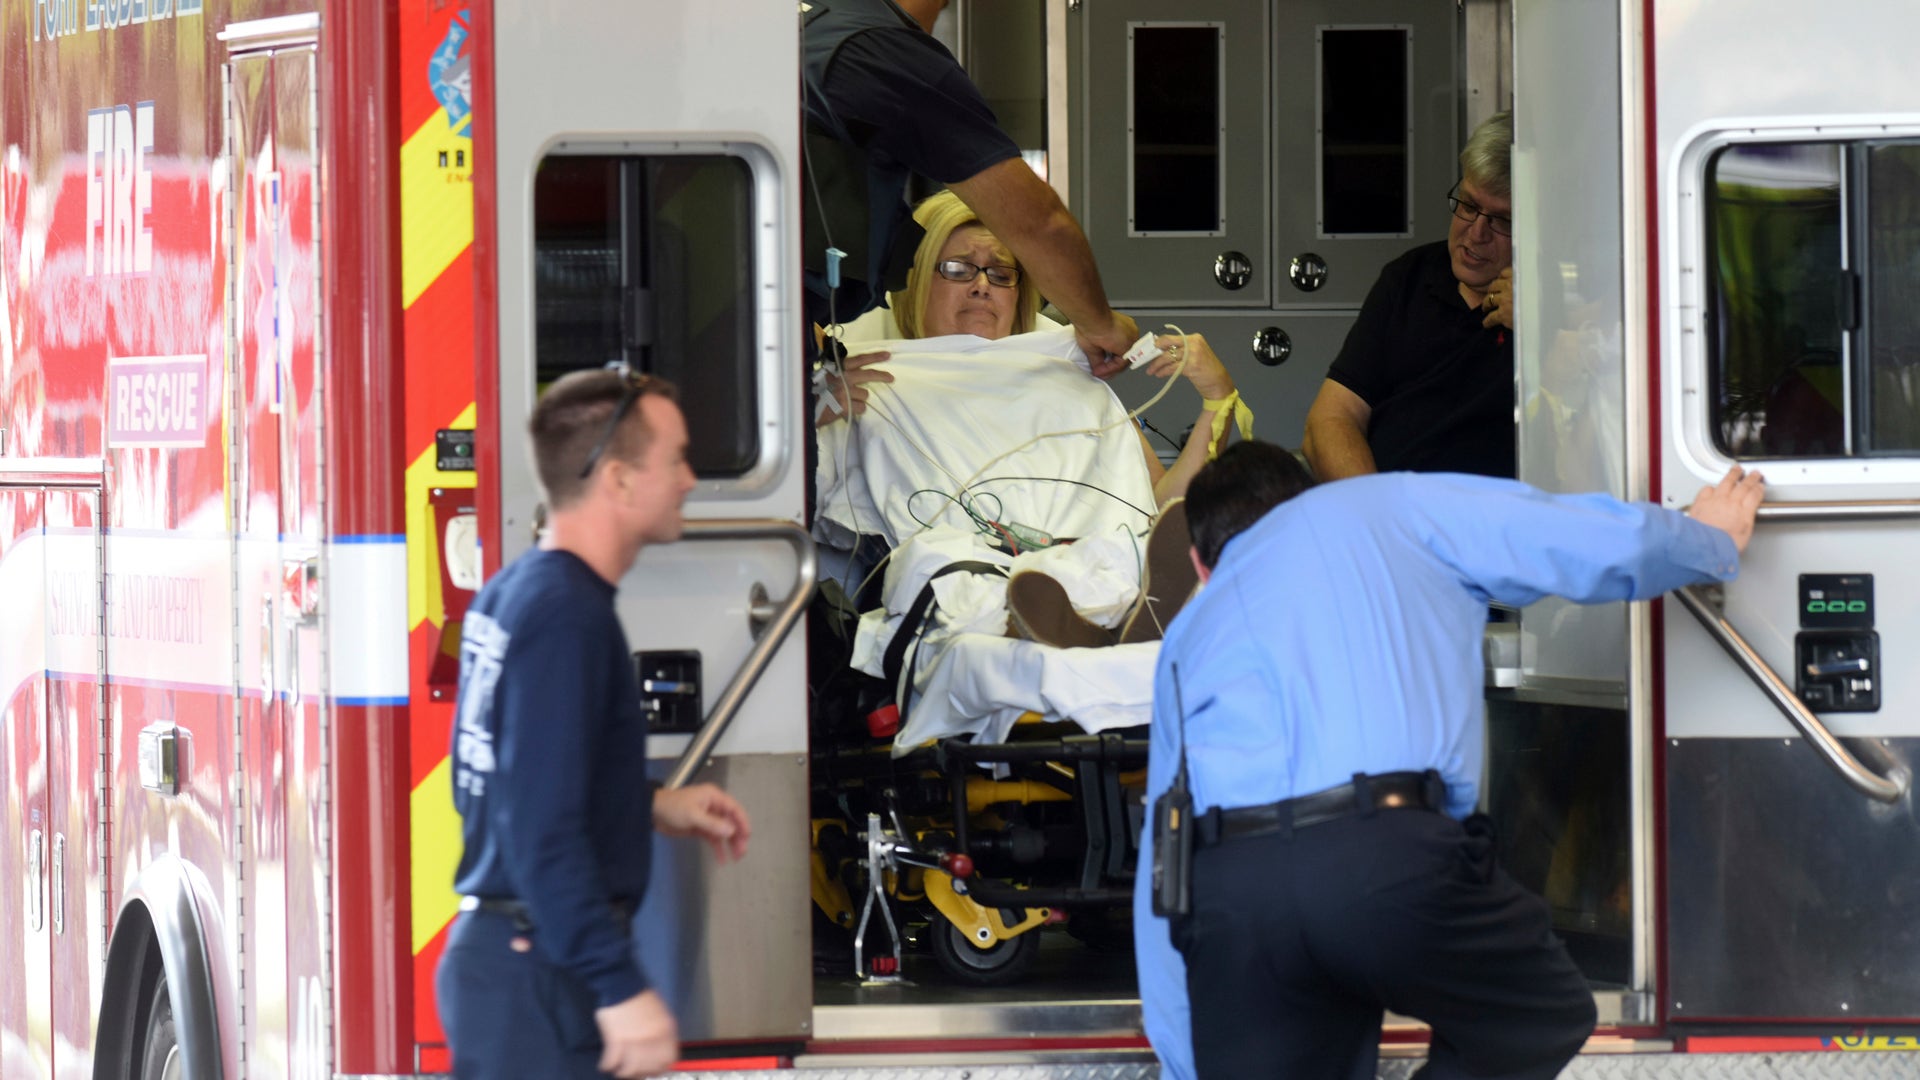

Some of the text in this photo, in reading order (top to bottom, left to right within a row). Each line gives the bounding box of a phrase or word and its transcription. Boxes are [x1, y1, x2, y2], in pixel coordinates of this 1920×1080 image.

[85, 100, 155, 281] FIRE
[116, 371, 199, 432] RESCUE
[90, 572, 117, 637] LE
[119, 573, 144, 639] AND
[147, 575, 206, 645] PROPERTY
